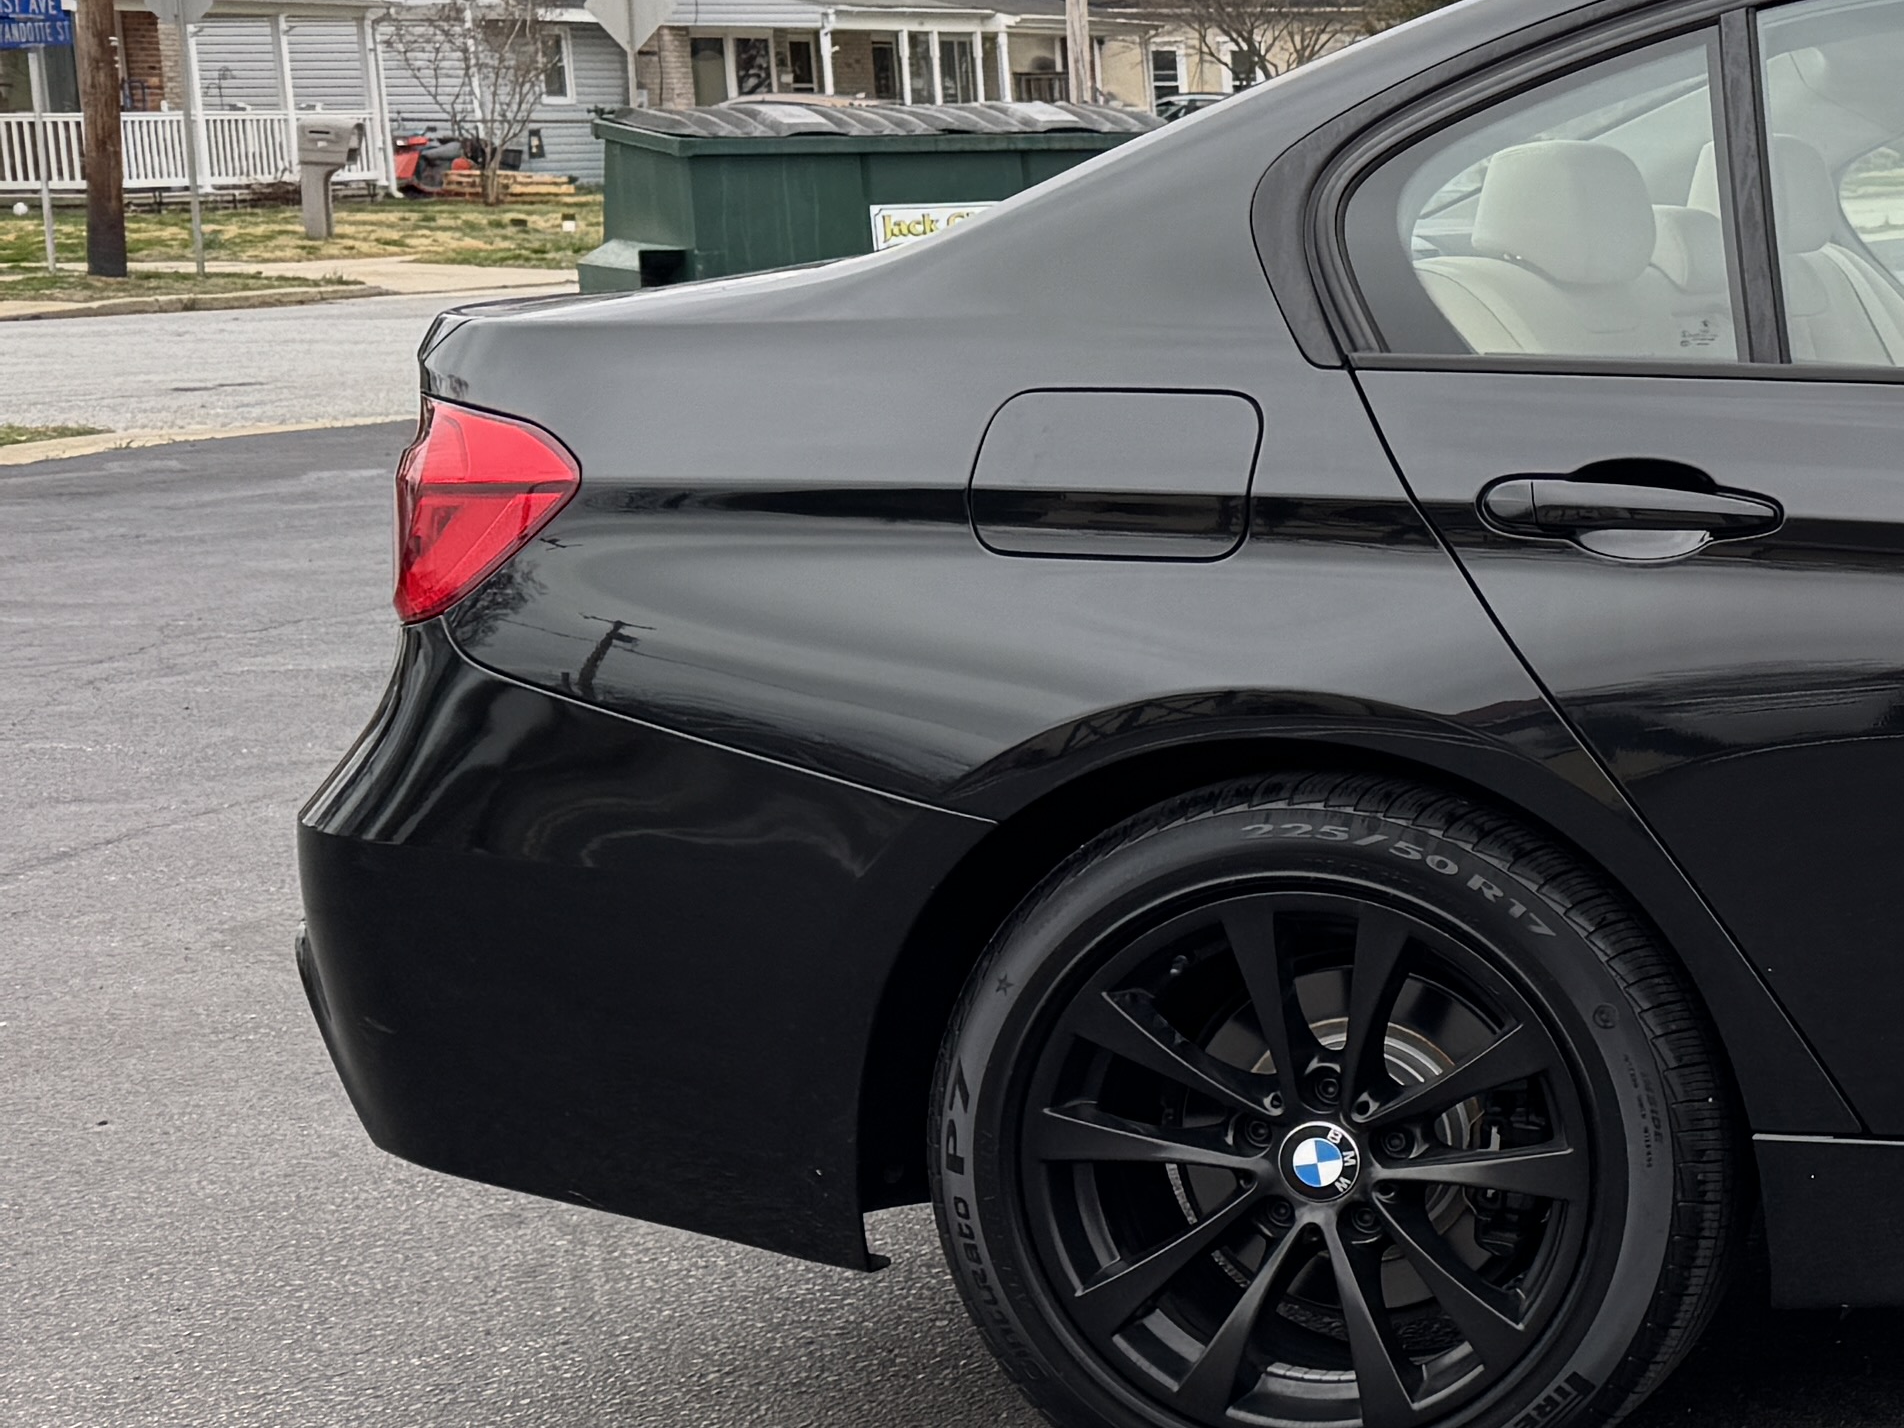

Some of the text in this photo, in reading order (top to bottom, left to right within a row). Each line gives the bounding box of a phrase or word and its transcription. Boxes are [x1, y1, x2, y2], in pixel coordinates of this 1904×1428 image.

[56, 21, 71, 42] ST
[882, 213, 940, 244] Jack
[1240, 821, 1558, 938] 225/50 R17
[945, 1058, 970, 1176] P7
[1327, 1127, 1357, 1193] BMW
